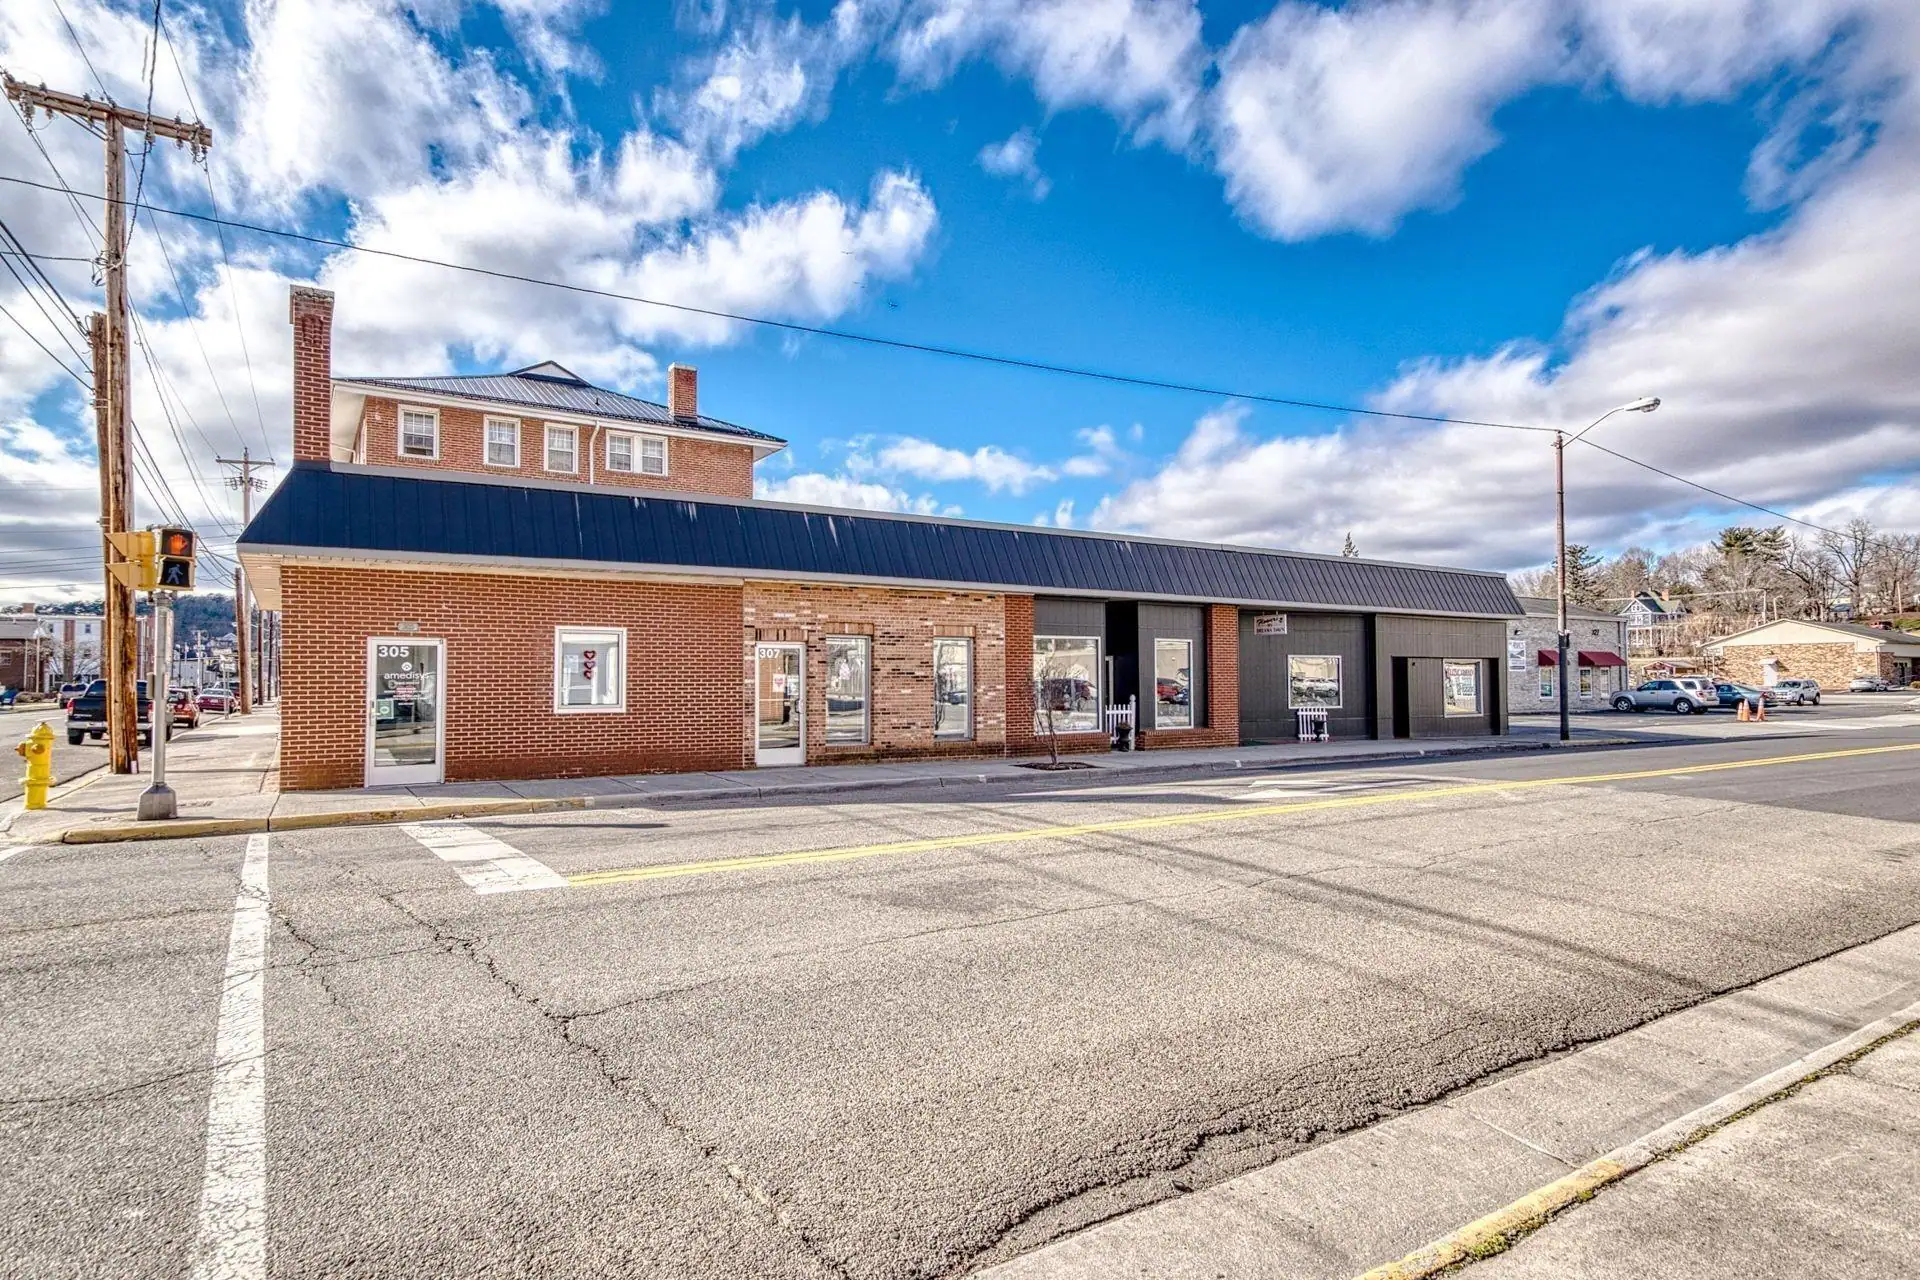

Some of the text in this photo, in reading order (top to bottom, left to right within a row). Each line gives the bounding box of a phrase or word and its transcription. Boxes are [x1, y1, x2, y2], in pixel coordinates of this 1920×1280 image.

[378, 646, 409, 657] 305
[760, 649, 780, 658] 307
[384, 671, 429, 681] amedisys
